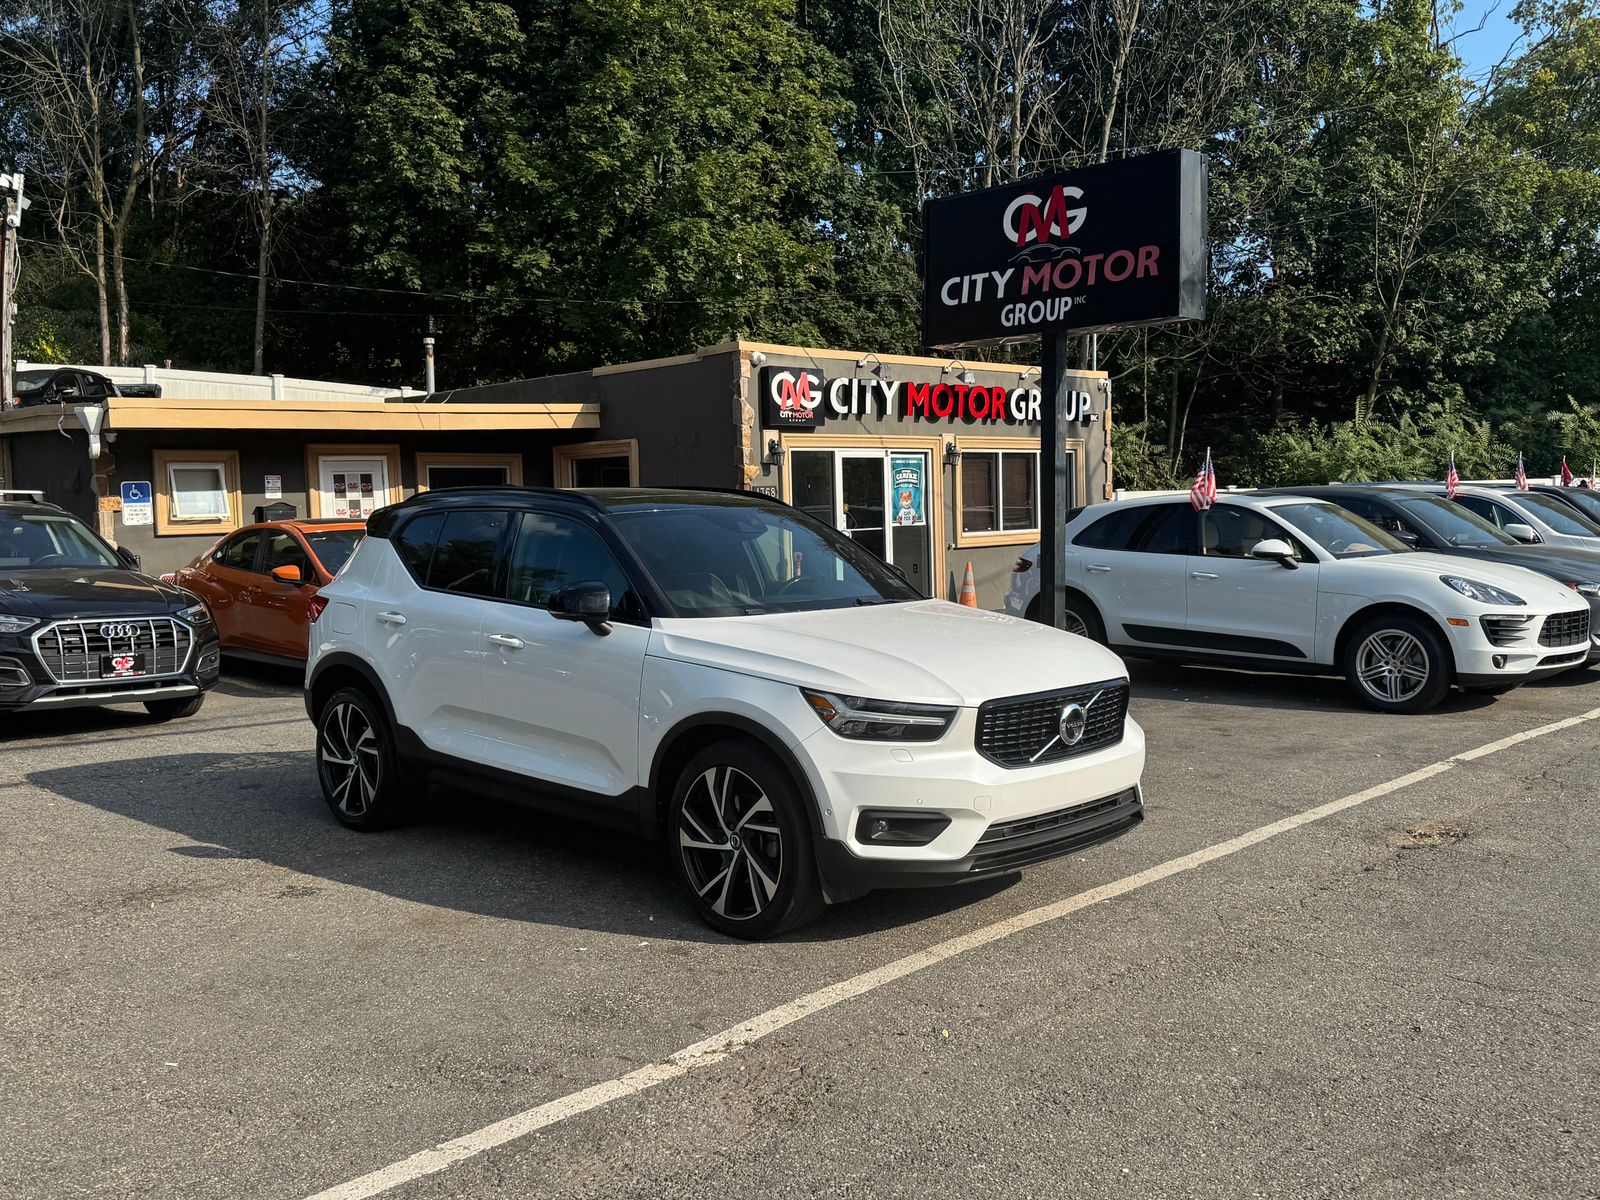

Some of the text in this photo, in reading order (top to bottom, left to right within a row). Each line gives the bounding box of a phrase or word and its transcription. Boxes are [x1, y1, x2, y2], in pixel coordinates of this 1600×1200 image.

[941, 245, 1160, 306] CITY MOTOR
[1000, 295, 1087, 327] GROUP INC
[830, 377, 900, 416] CITY
[907, 381, 1006, 420] MOTOR
[1010, 388, 1091, 422] GRUP
